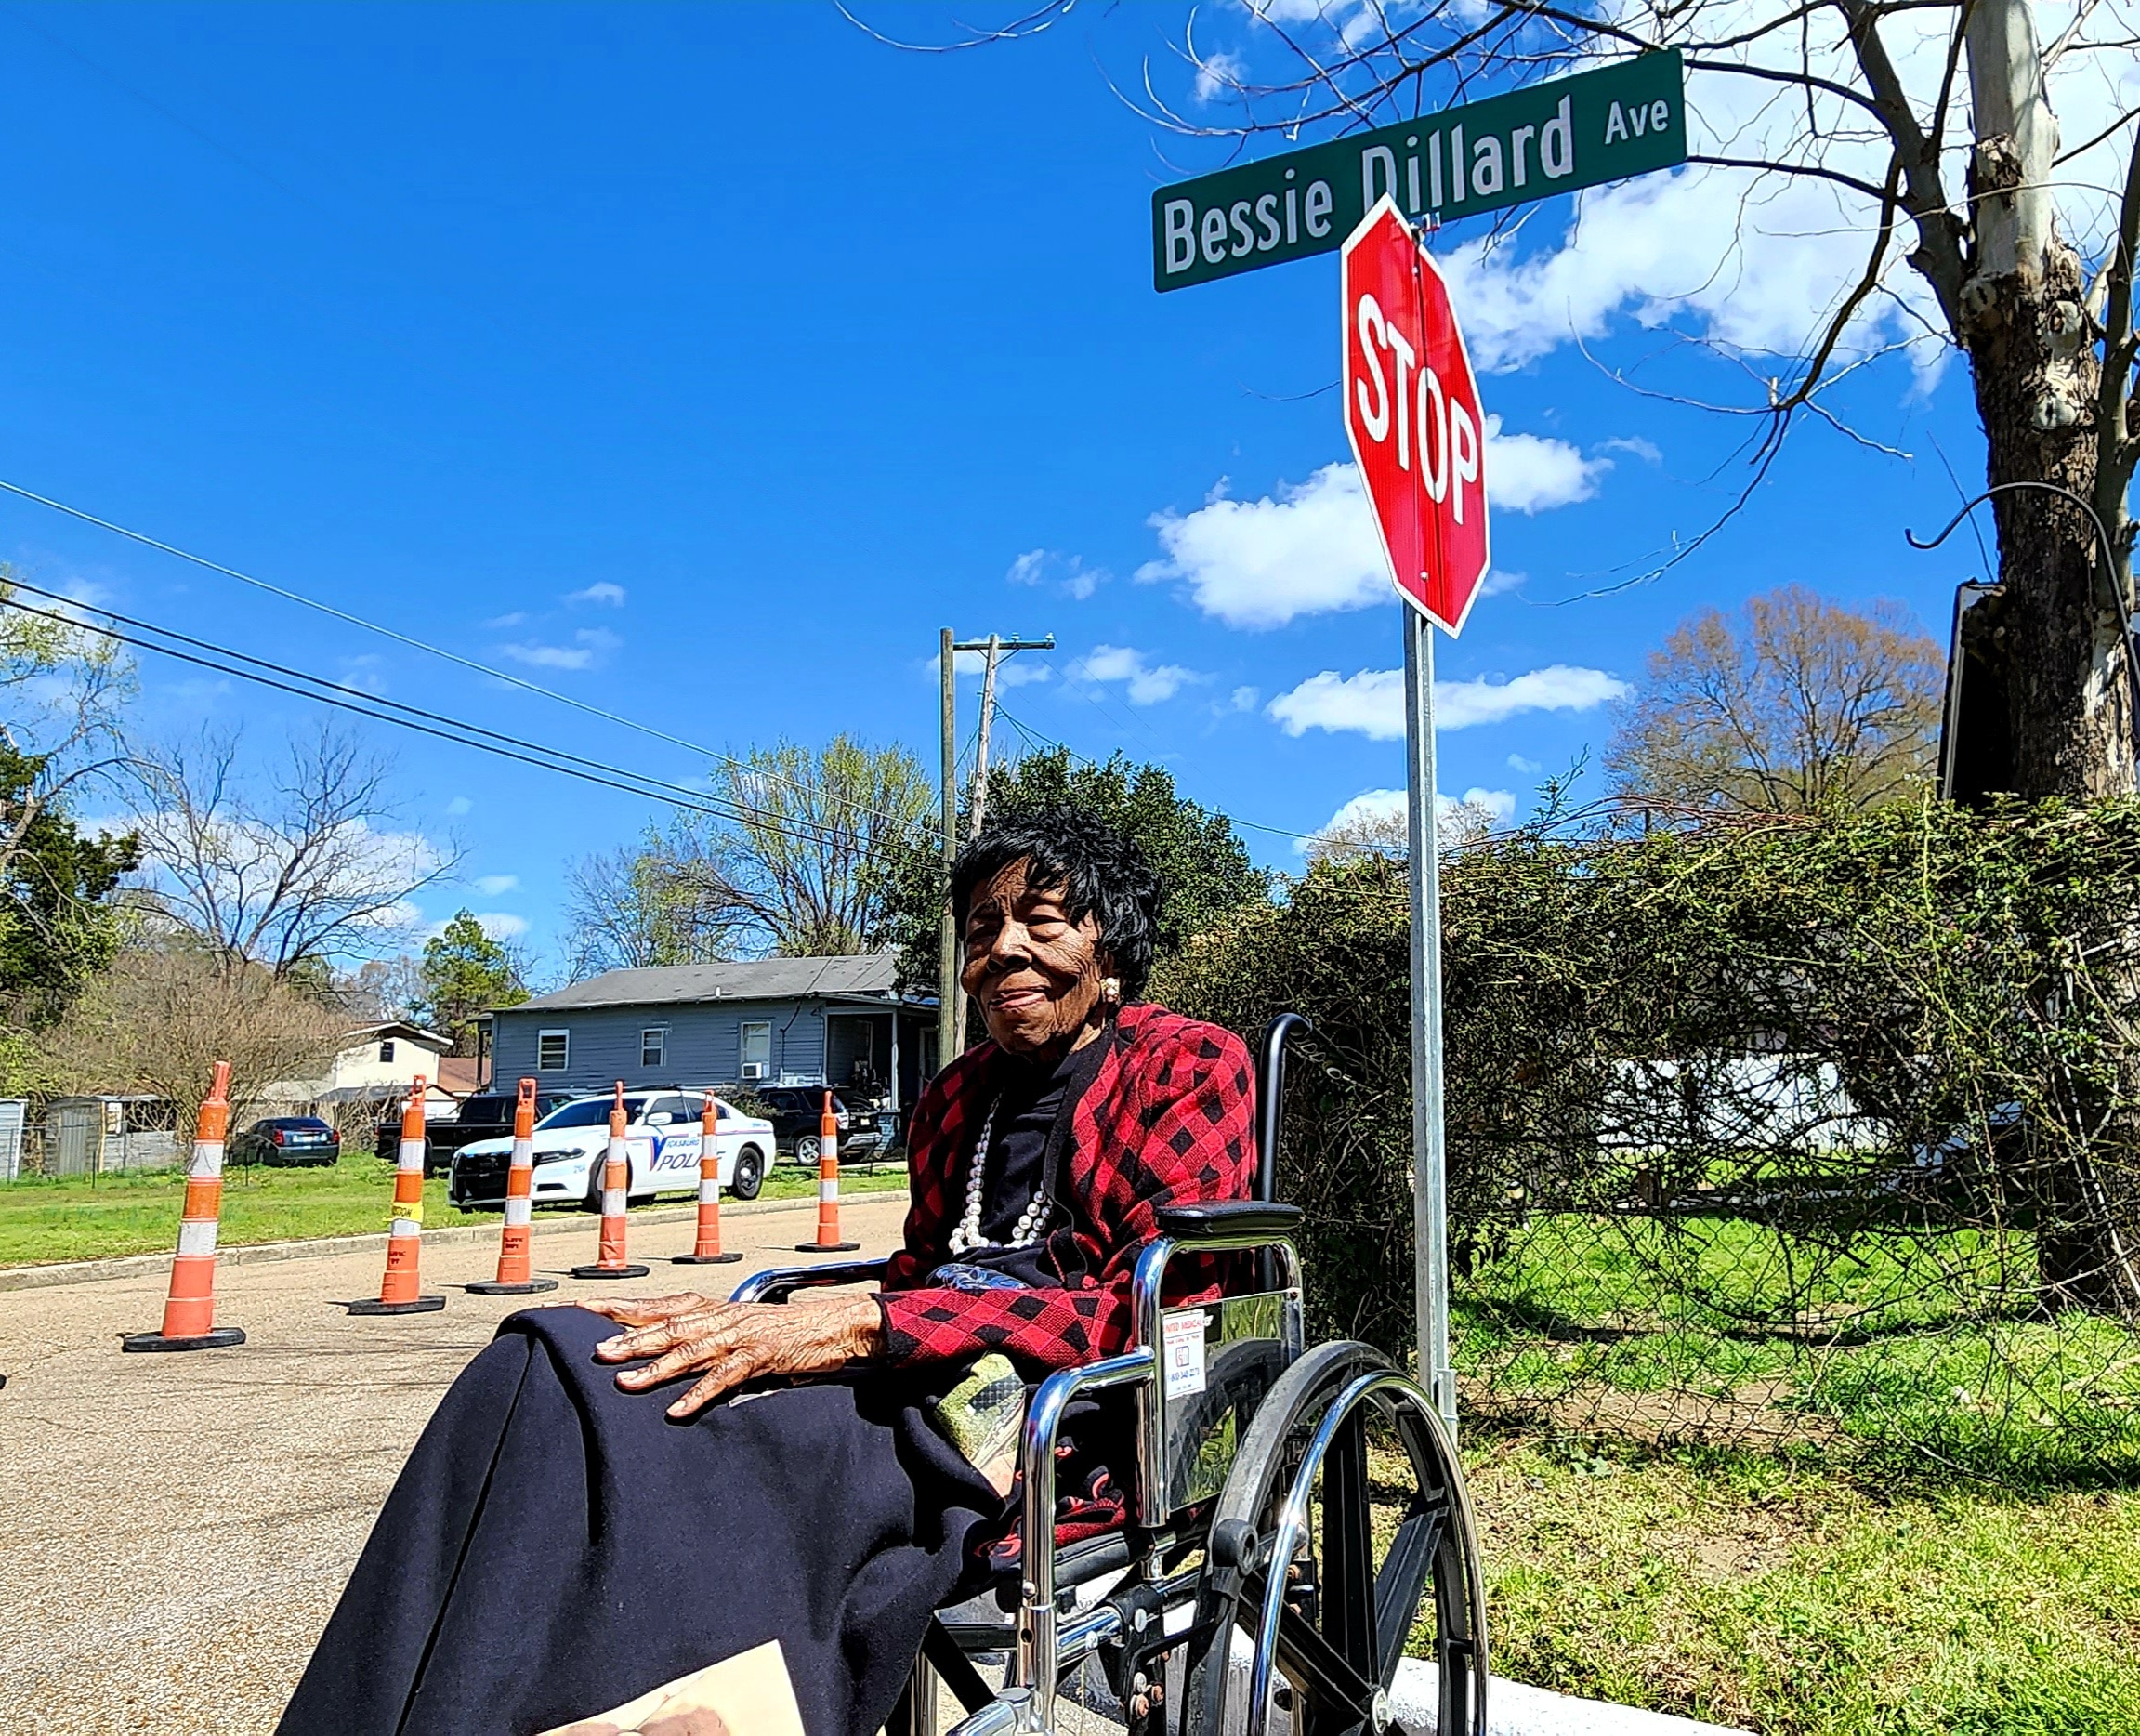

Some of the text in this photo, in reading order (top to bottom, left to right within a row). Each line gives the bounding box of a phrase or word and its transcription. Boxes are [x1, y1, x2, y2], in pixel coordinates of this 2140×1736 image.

[1163, 94, 1669, 275] Bessie Dillard Ave
[1356, 292, 1478, 526] STOP
